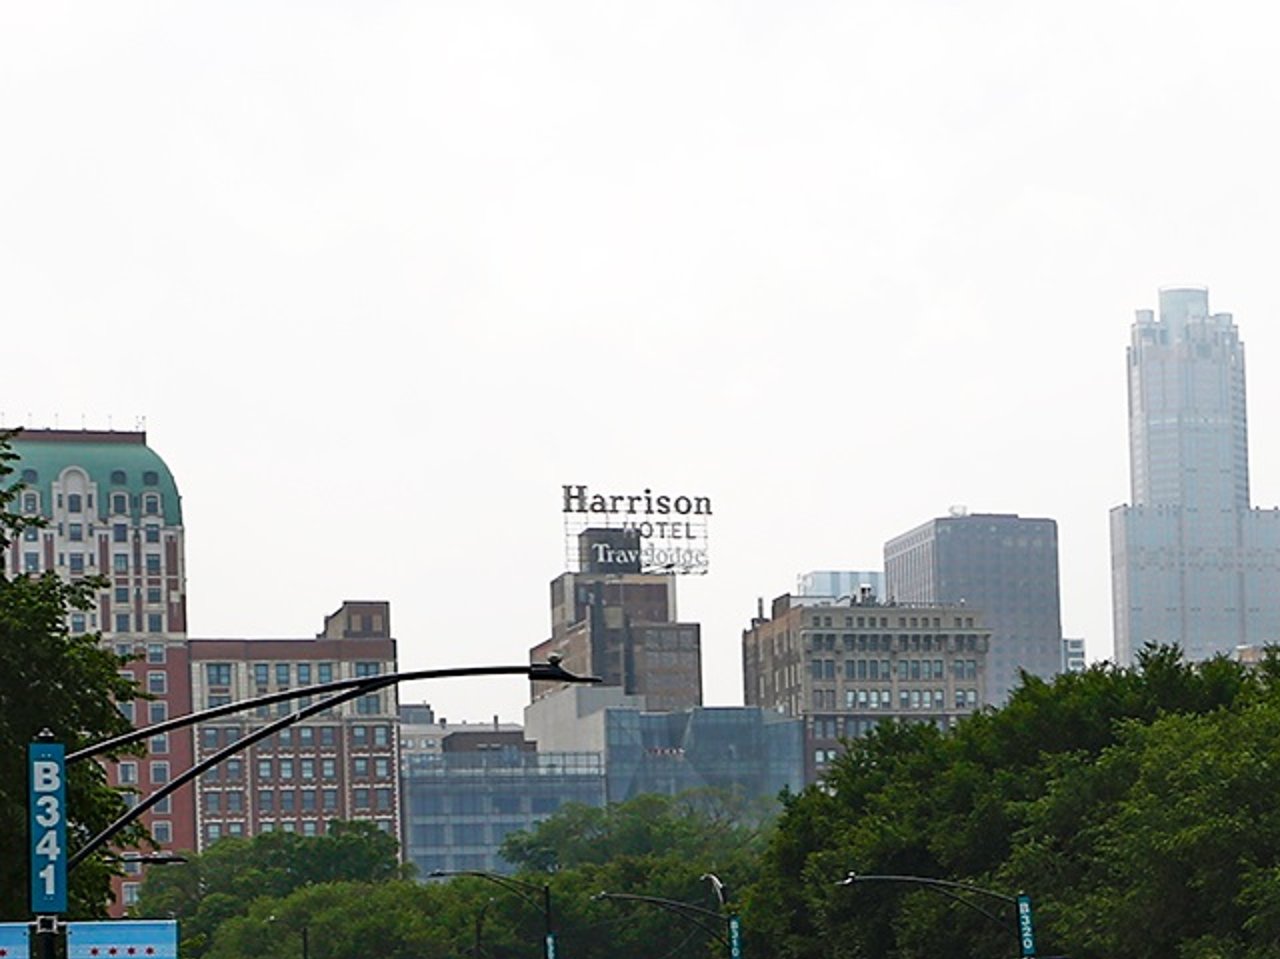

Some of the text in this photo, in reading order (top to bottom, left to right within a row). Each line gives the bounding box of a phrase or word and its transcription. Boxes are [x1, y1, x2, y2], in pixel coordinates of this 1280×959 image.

[562, 485, 713, 515] Harrison
[623, 521, 697, 539] HOTEL
[33, 761, 61, 895] B341
